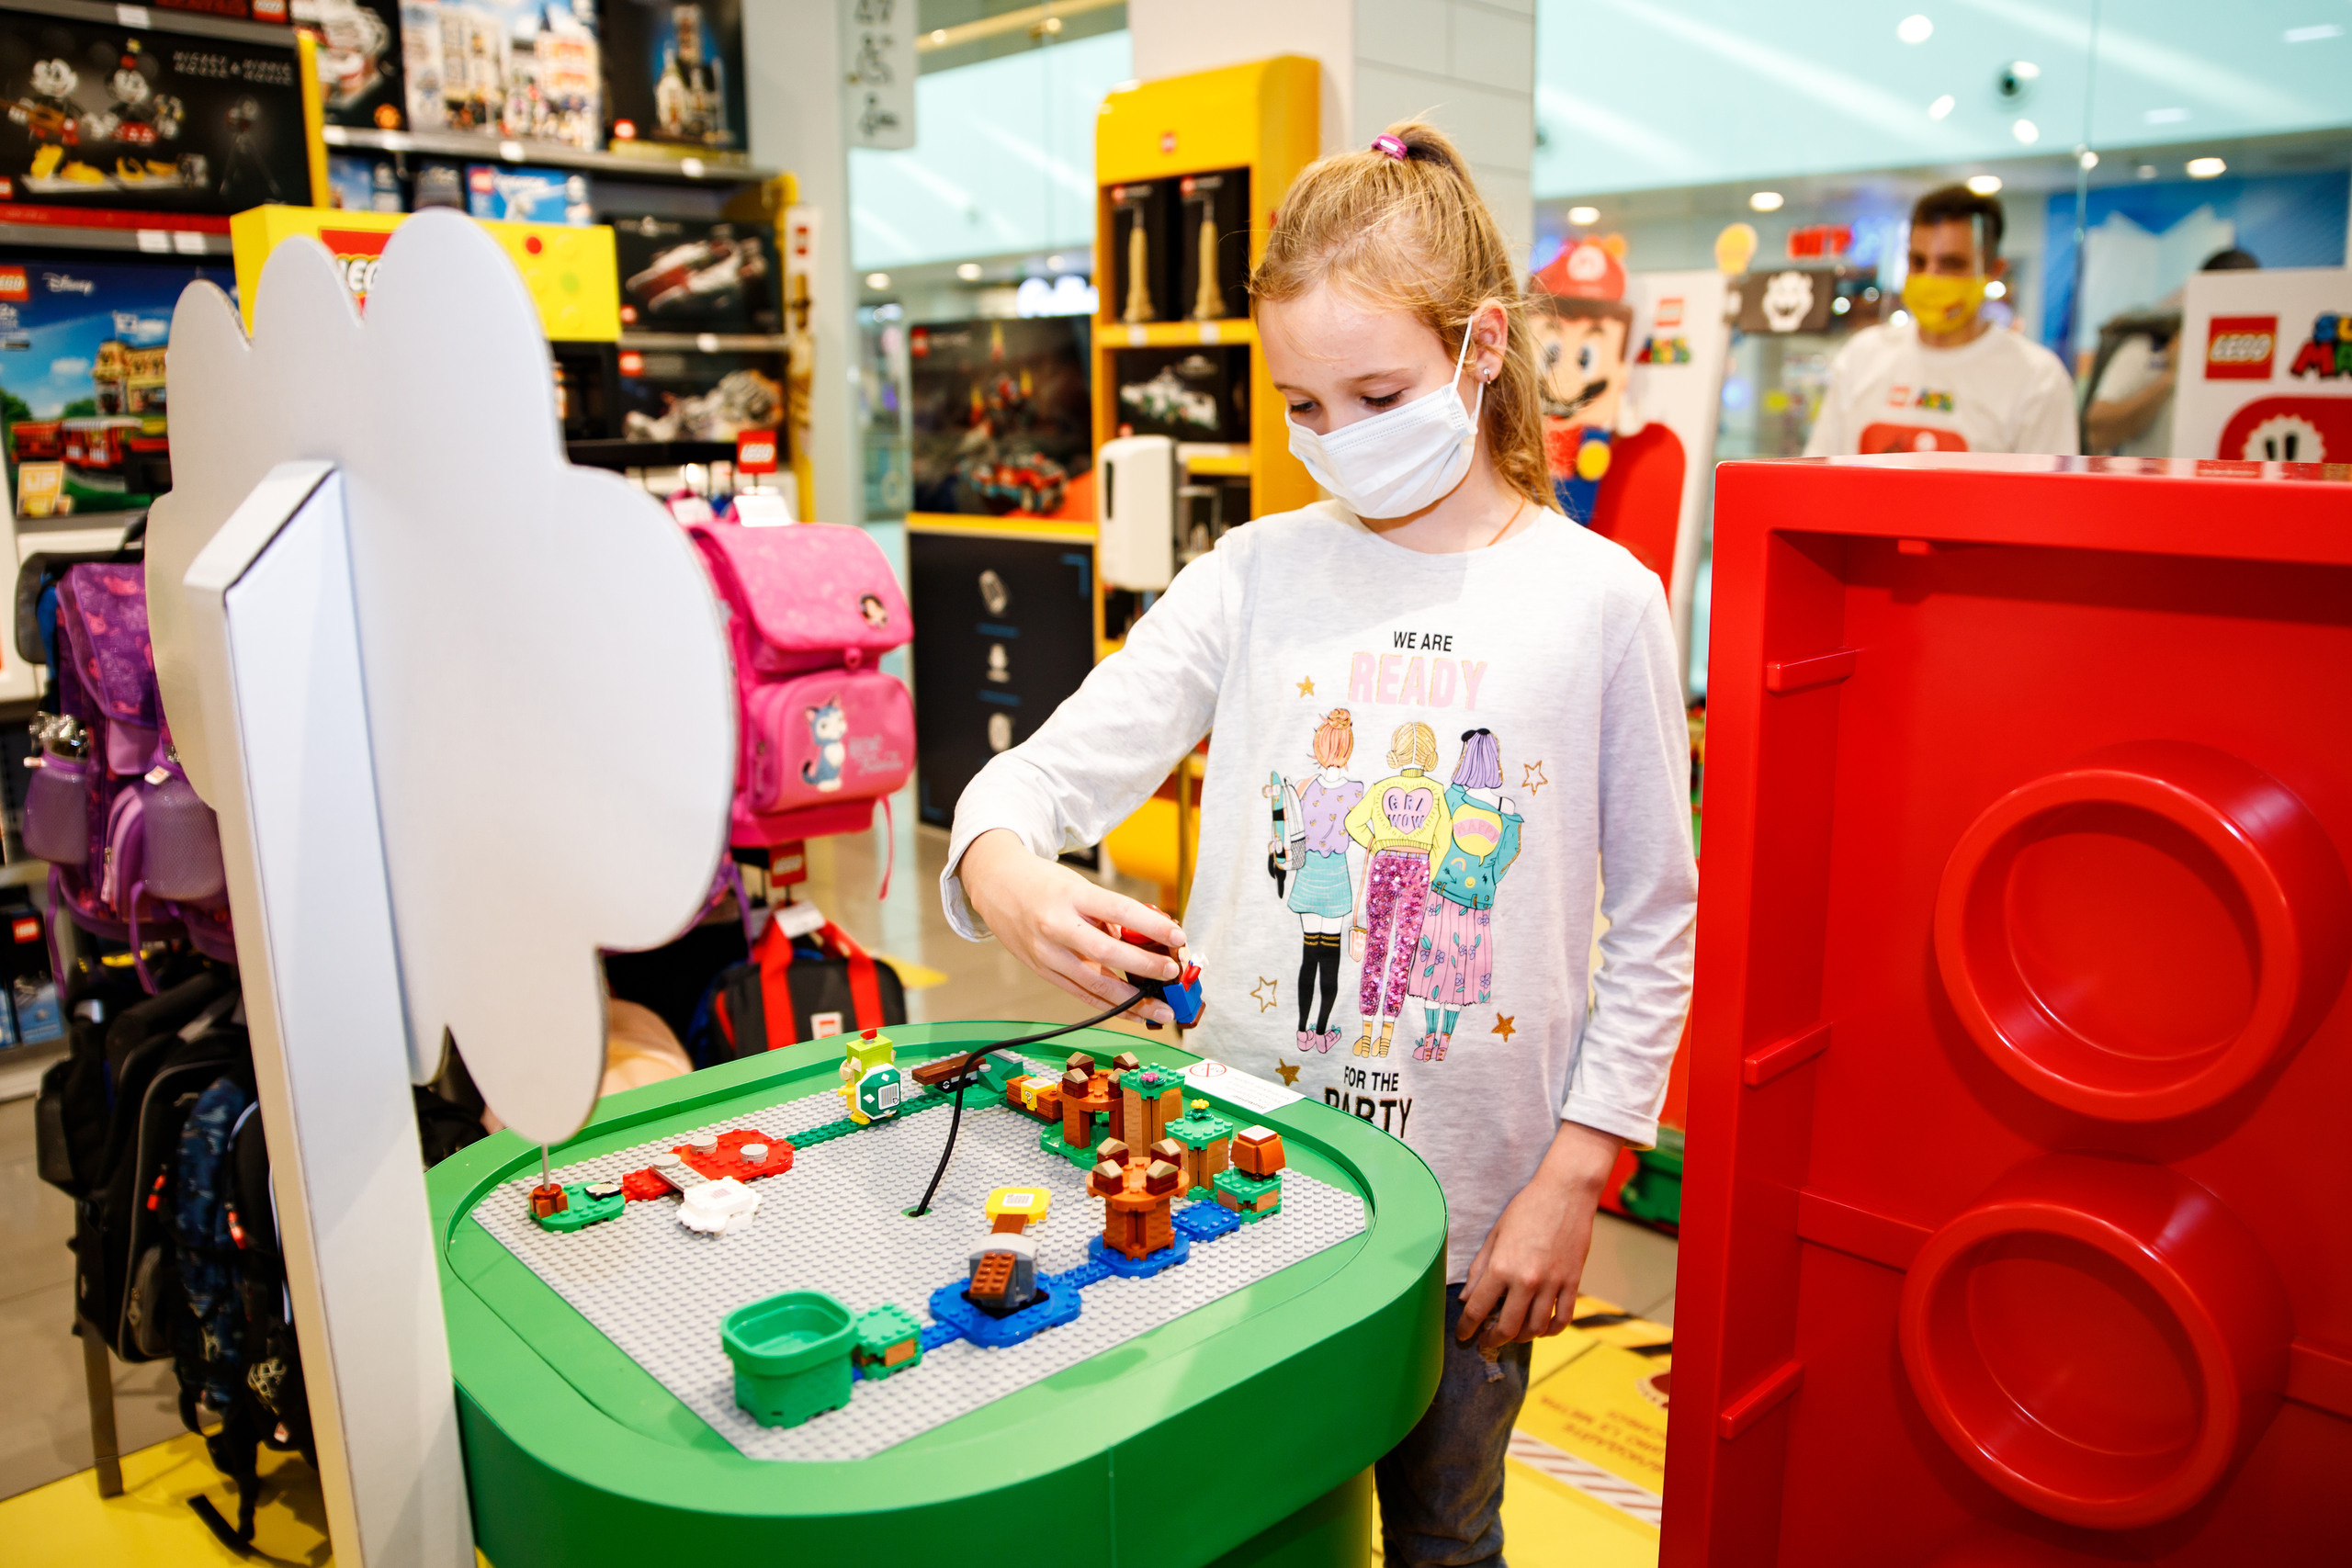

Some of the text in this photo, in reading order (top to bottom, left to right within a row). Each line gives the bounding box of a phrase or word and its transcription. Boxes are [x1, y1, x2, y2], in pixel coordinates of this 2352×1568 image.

[42, 272, 95, 296] Disney
[2210, 334, 2272, 362] LEGO
[1393, 630, 1453, 651] WE ARE
[1348, 651, 1487, 710] READY
[1387, 814, 1425, 830] WOW
[1344, 1066, 1399, 1092] FOR THE
